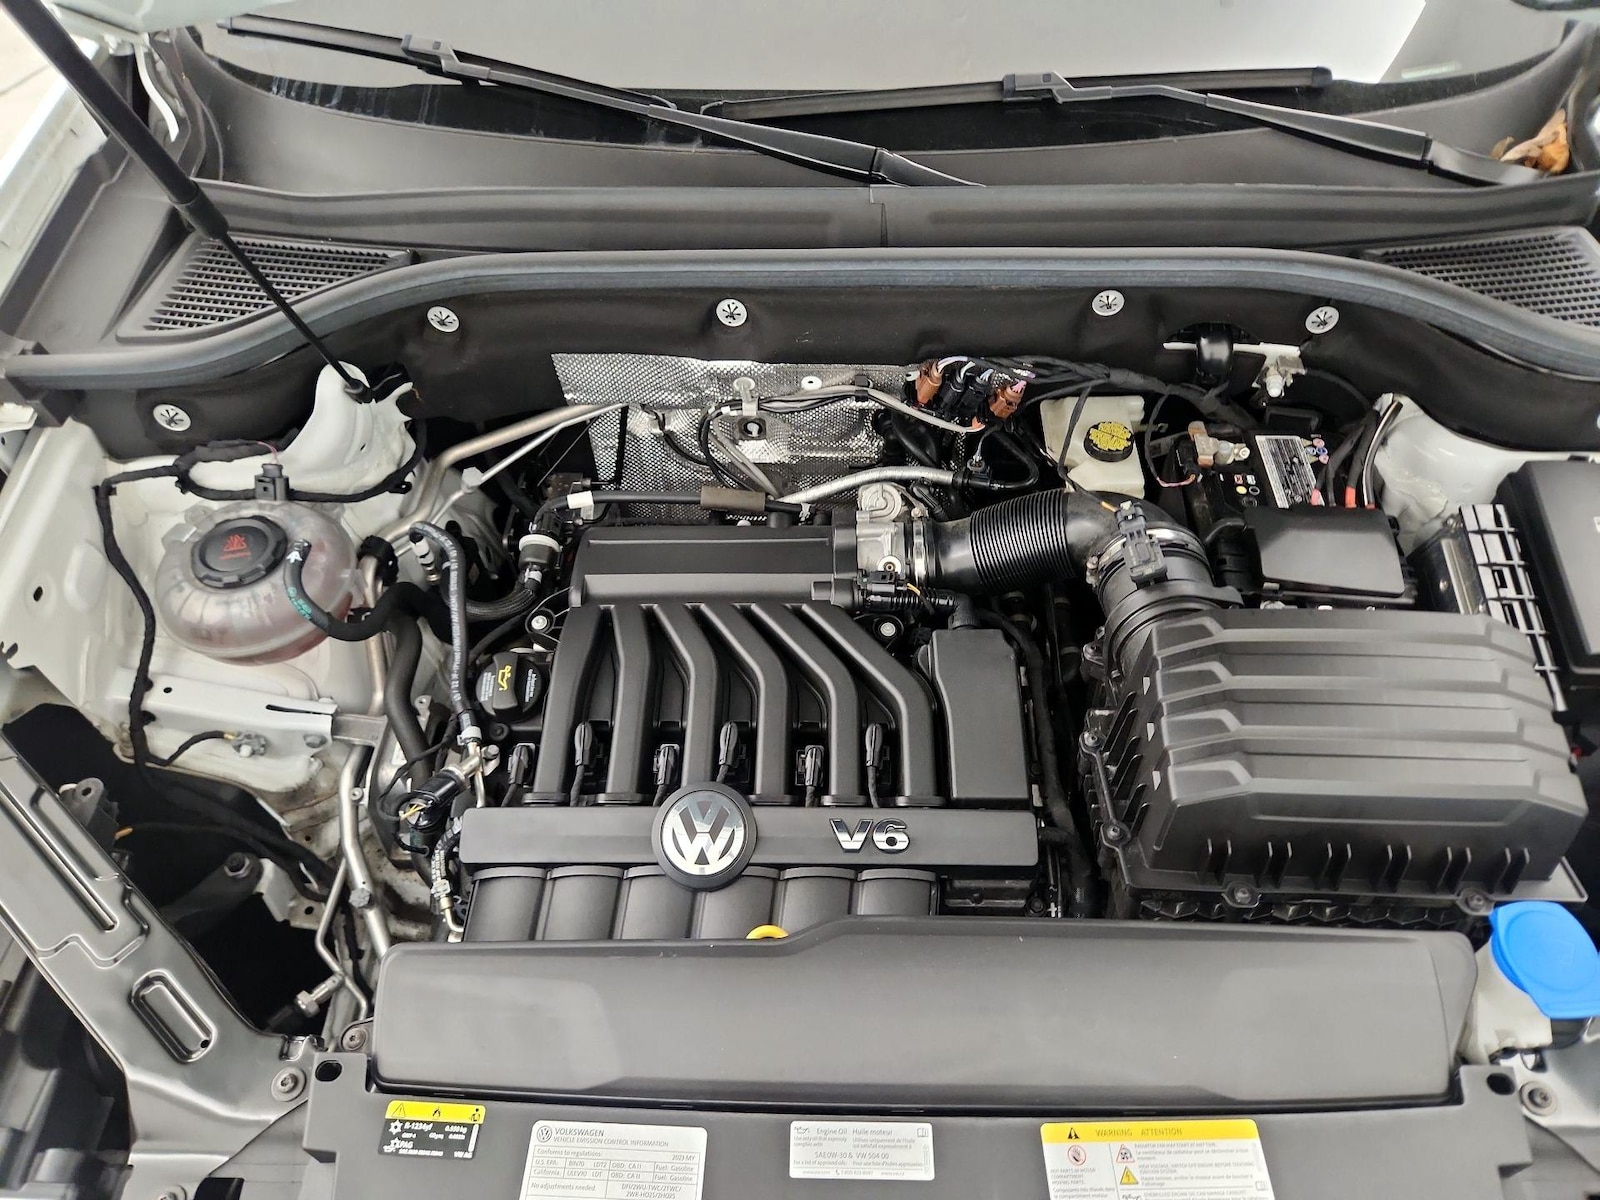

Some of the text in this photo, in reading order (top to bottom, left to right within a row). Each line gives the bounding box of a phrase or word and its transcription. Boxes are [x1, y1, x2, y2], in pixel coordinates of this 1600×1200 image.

[829, 817, 911, 854] V6
[555, 1127, 605, 1137] VOLKSWAGEN
[816, 1128, 838, 1136] Engine
[1095, 1128, 1183, 1137] WARNING ATTENTION
